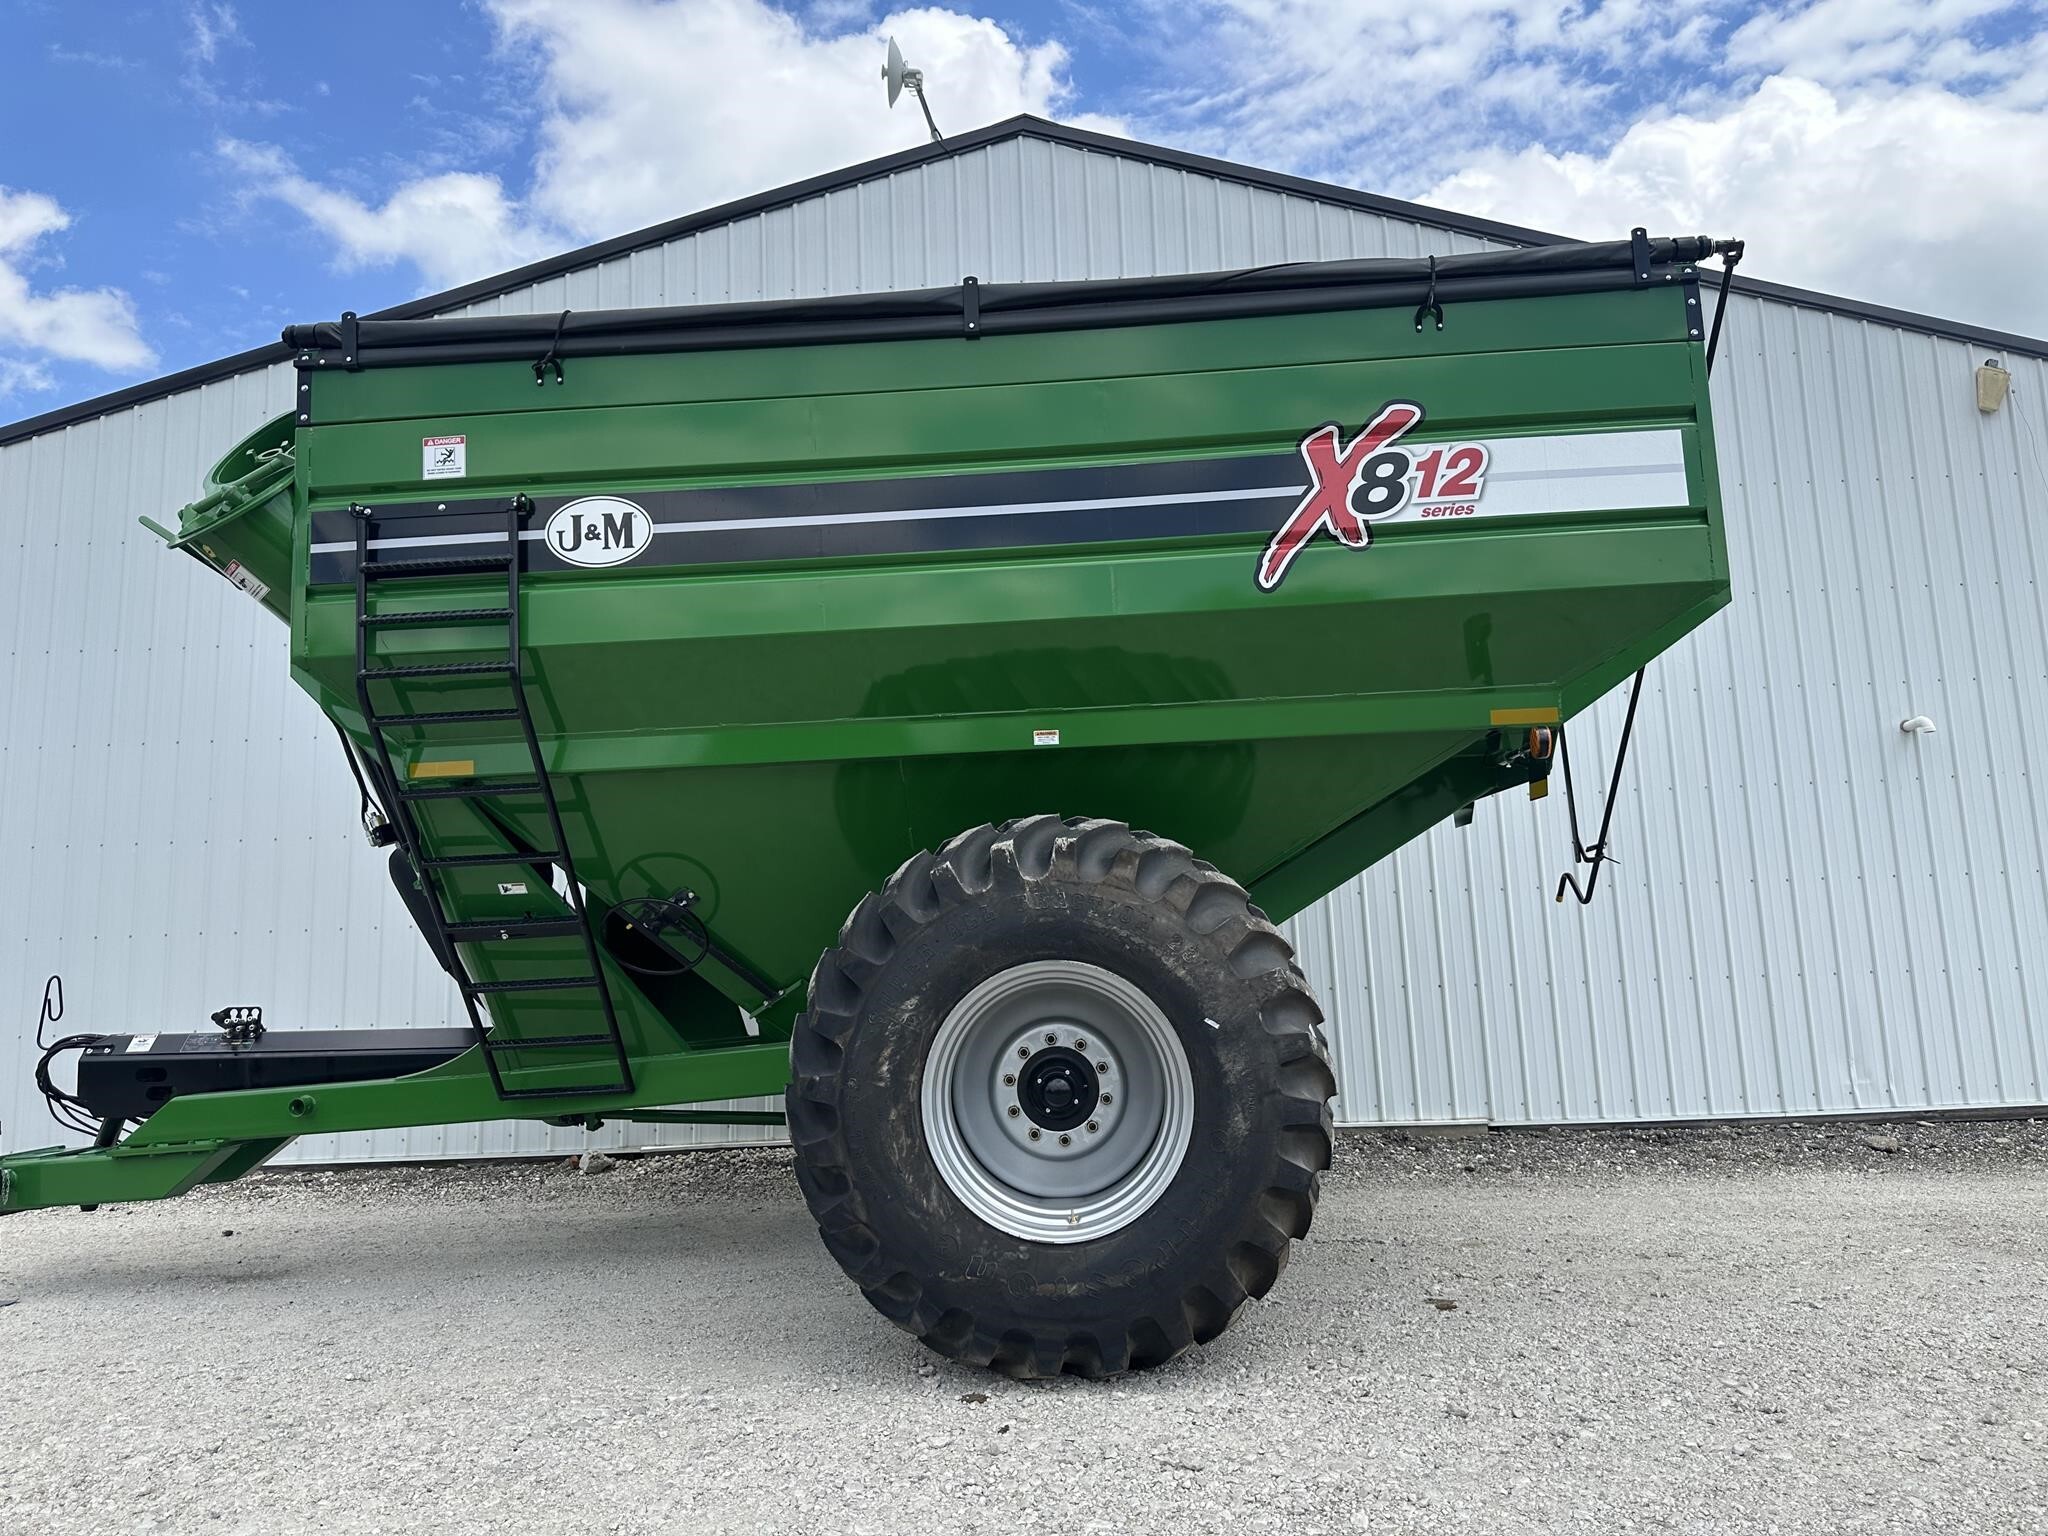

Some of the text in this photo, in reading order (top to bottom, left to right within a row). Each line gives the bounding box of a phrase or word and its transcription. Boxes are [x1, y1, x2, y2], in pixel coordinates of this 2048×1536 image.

[434, 437, 462, 445] DANGER
[1421, 503, 1476, 518] series
[556, 512, 635, 552] J&M
